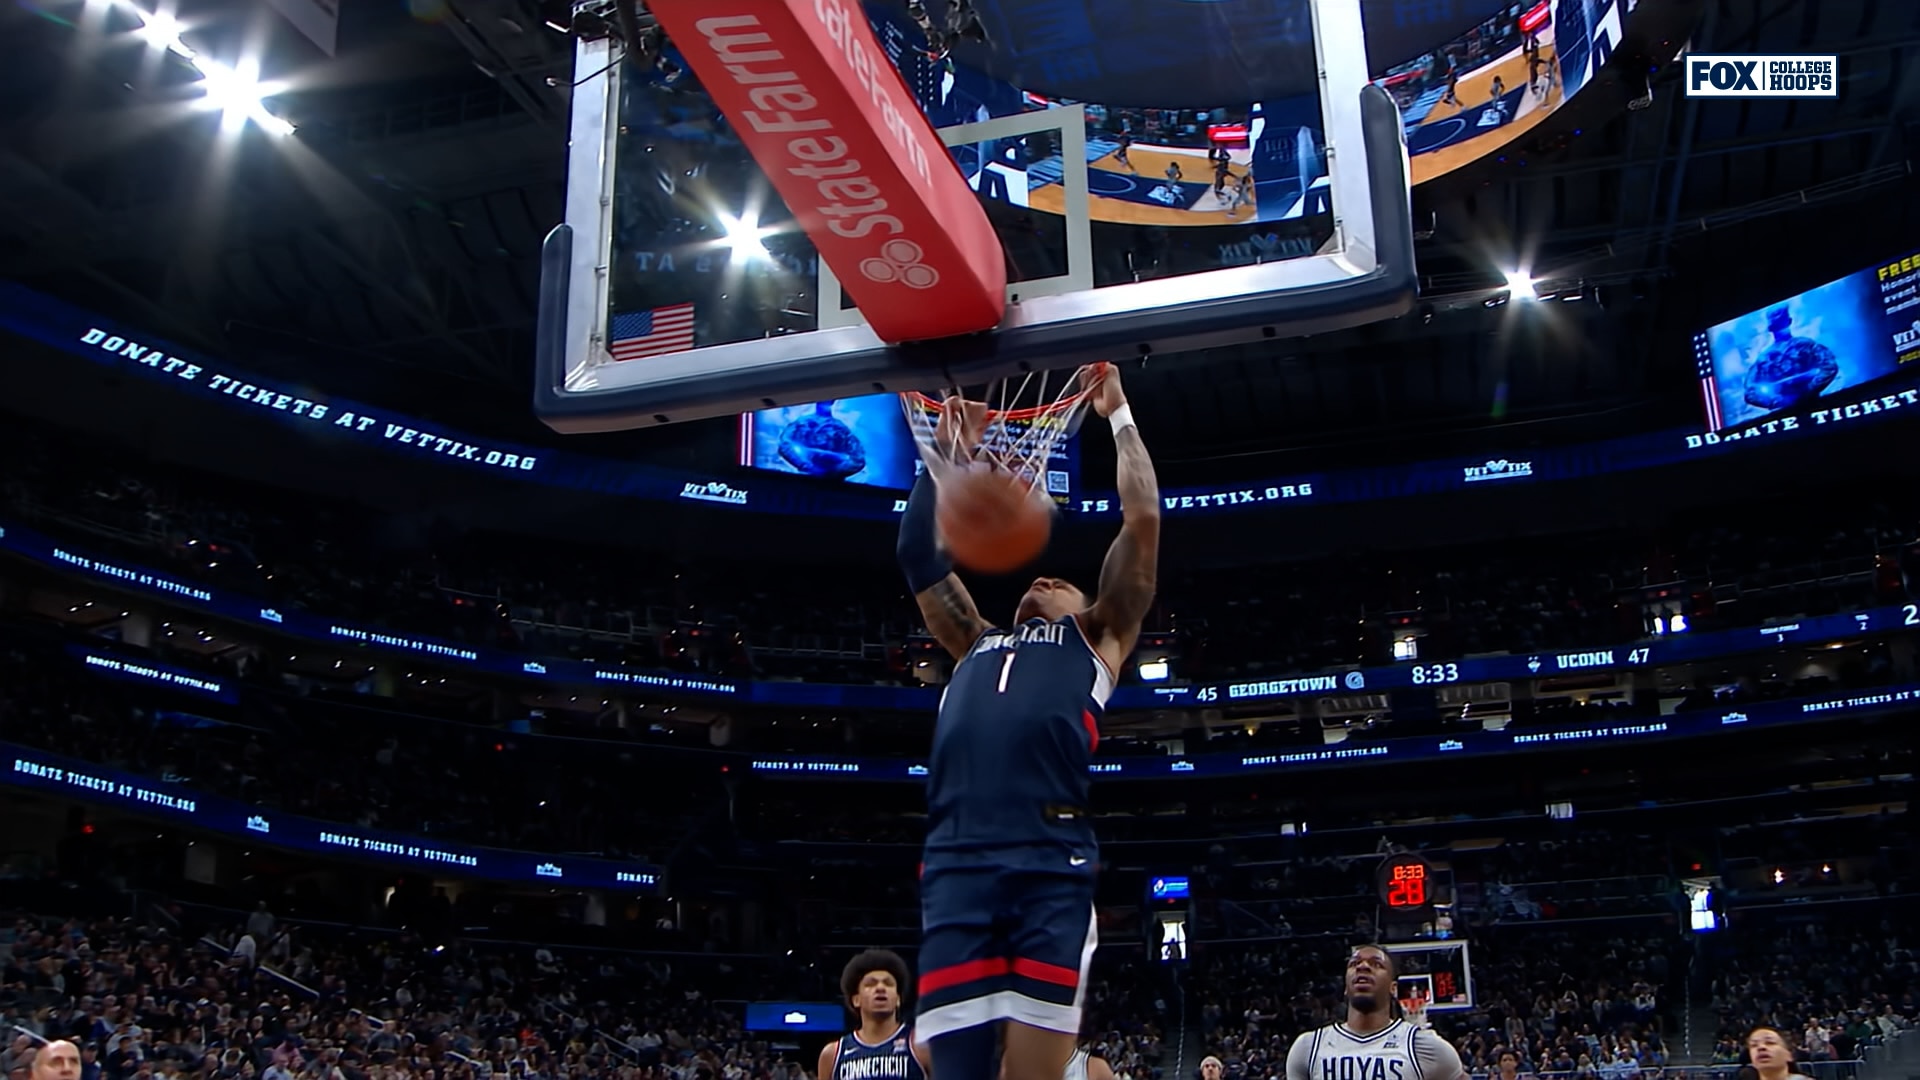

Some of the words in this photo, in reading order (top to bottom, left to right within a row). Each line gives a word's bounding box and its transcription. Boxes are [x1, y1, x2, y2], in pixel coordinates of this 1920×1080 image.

[1877, 253, 1920, 281] FREE
[80, 328, 203, 380] DONATE
[208, 374, 329, 419] TICKETS
[334, 412, 376, 431] AT
[384, 423, 537, 471] VETTIX.ORG
[1810, 388, 1919, 425] TICKET
[1164, 483, 1313, 509] VETTIX.ORG
[1556, 650, 1615, 669] UCONN
[1628, 647, 1650, 664] 47
[998, 652, 1016, 694] 1
[1411, 663, 1459, 684] 8:33
[1196, 686, 1218, 702] 45
[1228, 675, 1337, 698] GEORGETOWN
[14, 759, 63, 781] DONATE
[67, 771, 115, 793] TICKETS
[118, 784, 133, 797] AT
[1387, 879, 1425, 906] 28
[840, 1056, 909, 1080] CONNECTICUT
[1322, 1055, 1404, 1080] HOYAS
